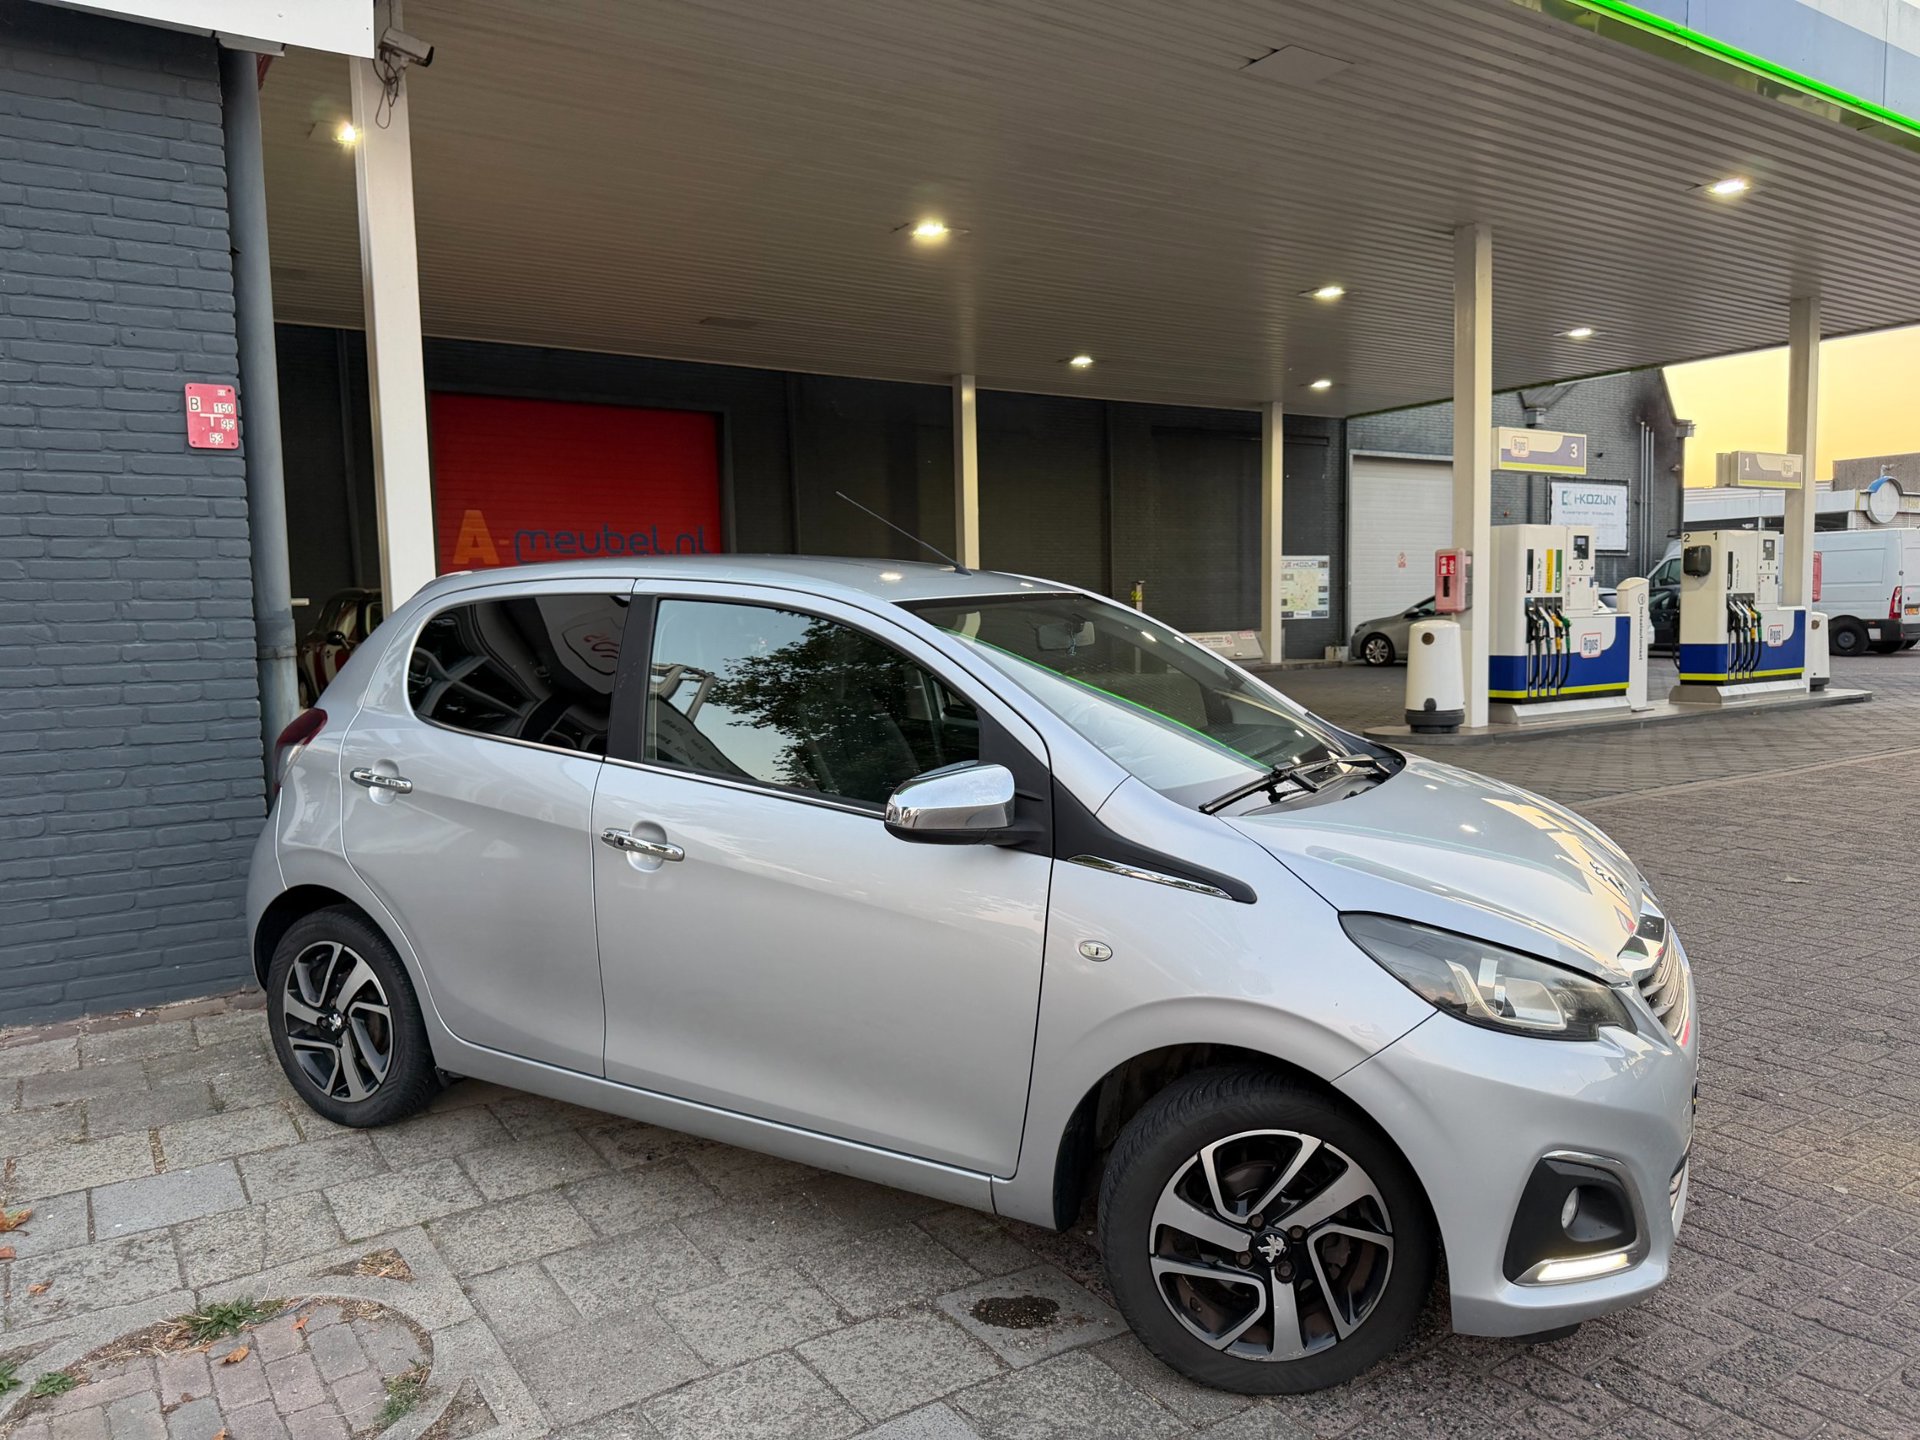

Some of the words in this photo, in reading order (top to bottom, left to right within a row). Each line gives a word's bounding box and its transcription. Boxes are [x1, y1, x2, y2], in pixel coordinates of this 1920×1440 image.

[189, 397, 200, 411] B
[215, 403, 234, 414] 150
[1569, 443, 1578, 458] 3
[1744, 457, 1750, 471] 1
[1683, 533, 1691, 543] 2
[1712, 531, 1718, 541] 1
[1578, 560, 1584, 570] 3
[1583, 637, 1598, 654] Argos
